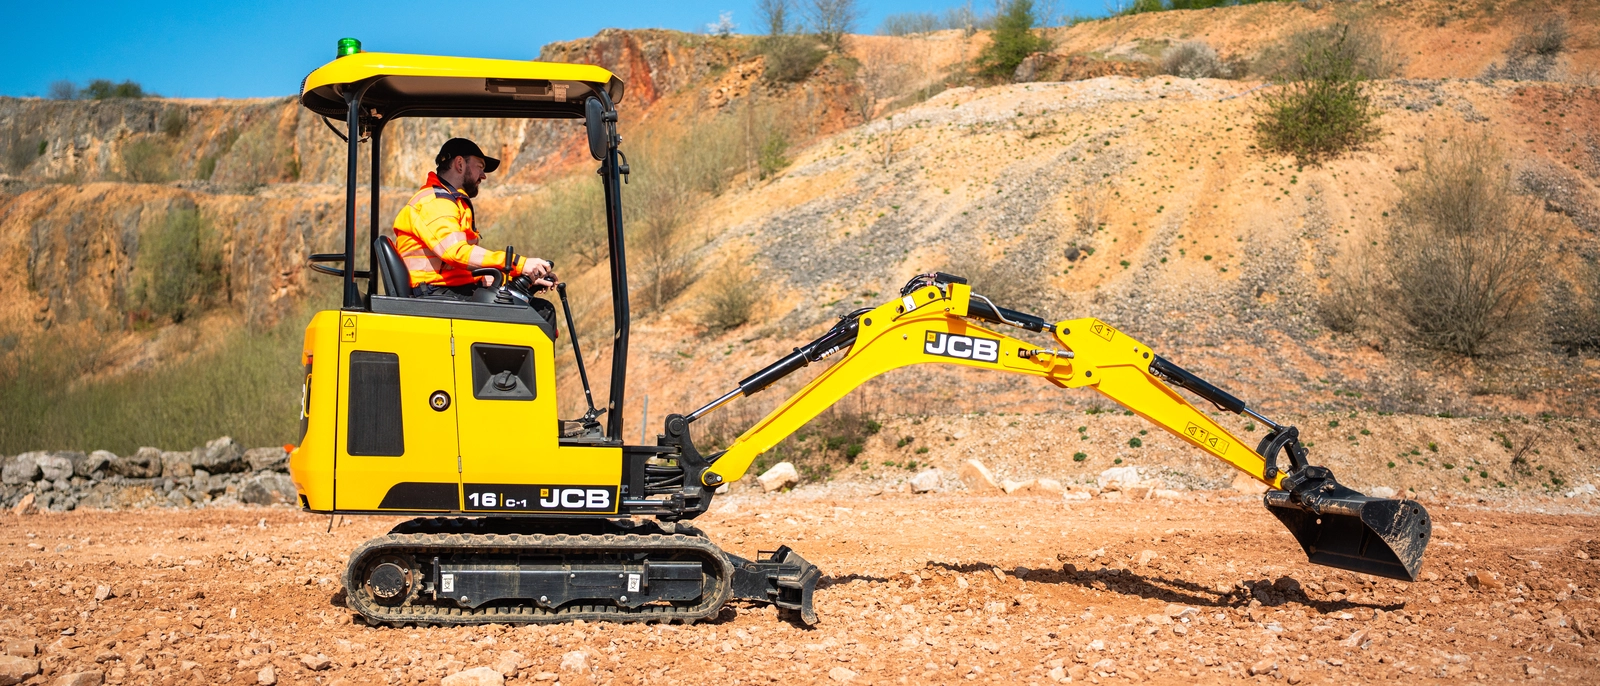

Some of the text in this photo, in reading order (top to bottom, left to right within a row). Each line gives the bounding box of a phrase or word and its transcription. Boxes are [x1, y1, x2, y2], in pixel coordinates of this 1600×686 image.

[925, 332, 998, 361] JCB
[468, 492, 497, 507] 16
[540, 488, 610, 508] JCB
